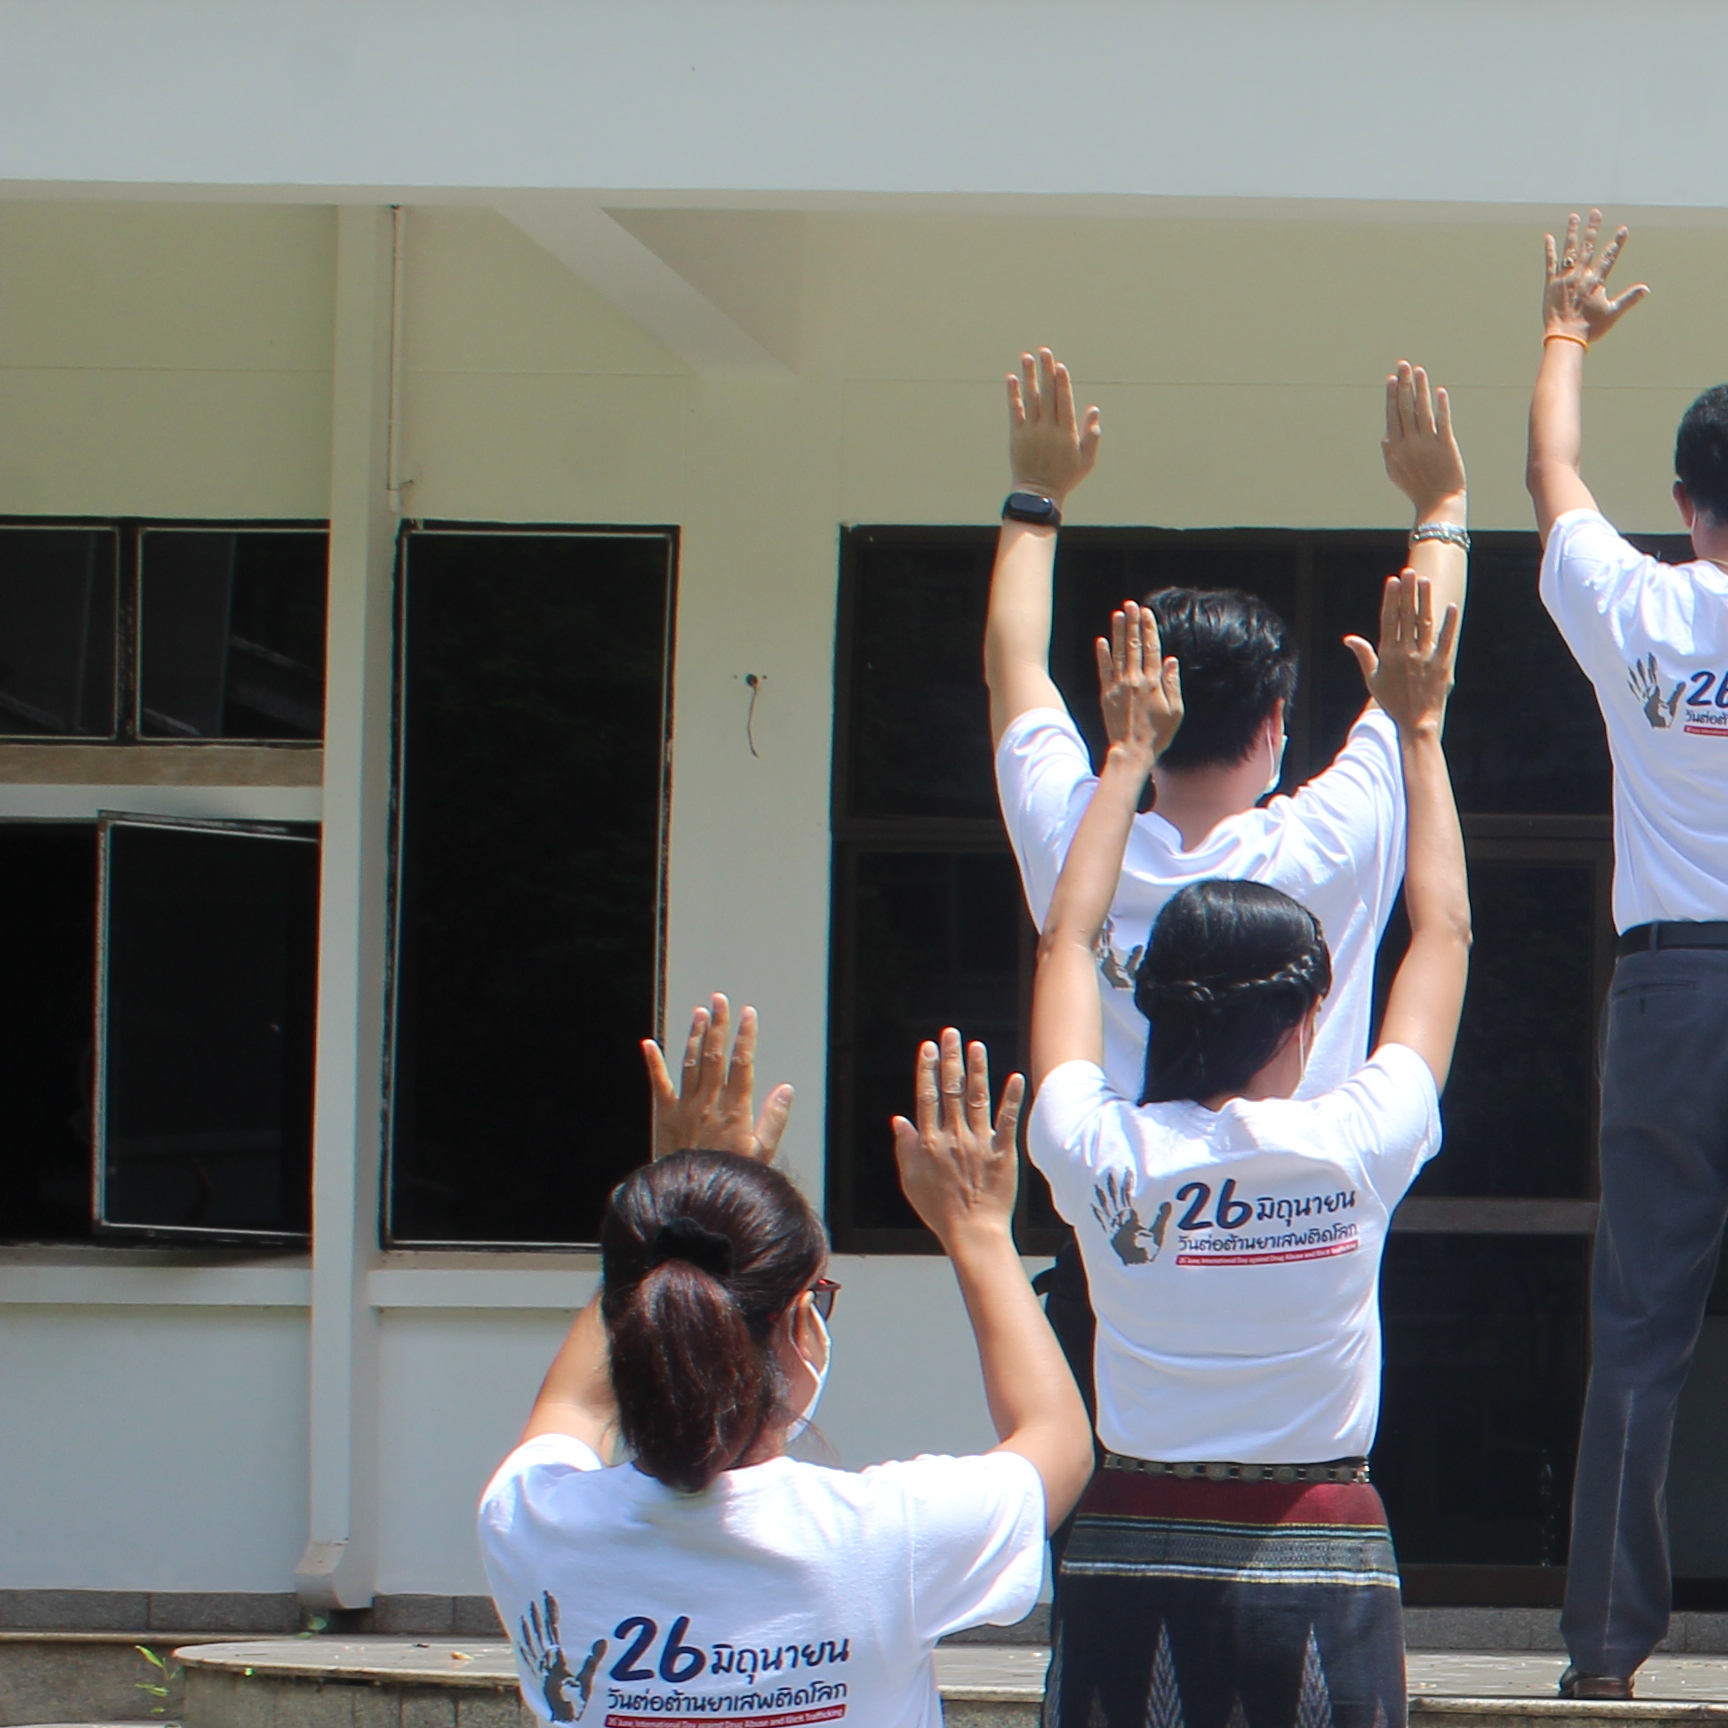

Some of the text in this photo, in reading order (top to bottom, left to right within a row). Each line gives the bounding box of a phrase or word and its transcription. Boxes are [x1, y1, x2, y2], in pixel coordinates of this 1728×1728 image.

[1176, 1178, 1355, 1230] 26 มิถุนายน
[609, 1616, 850, 1685] 26 มิถุนายน
